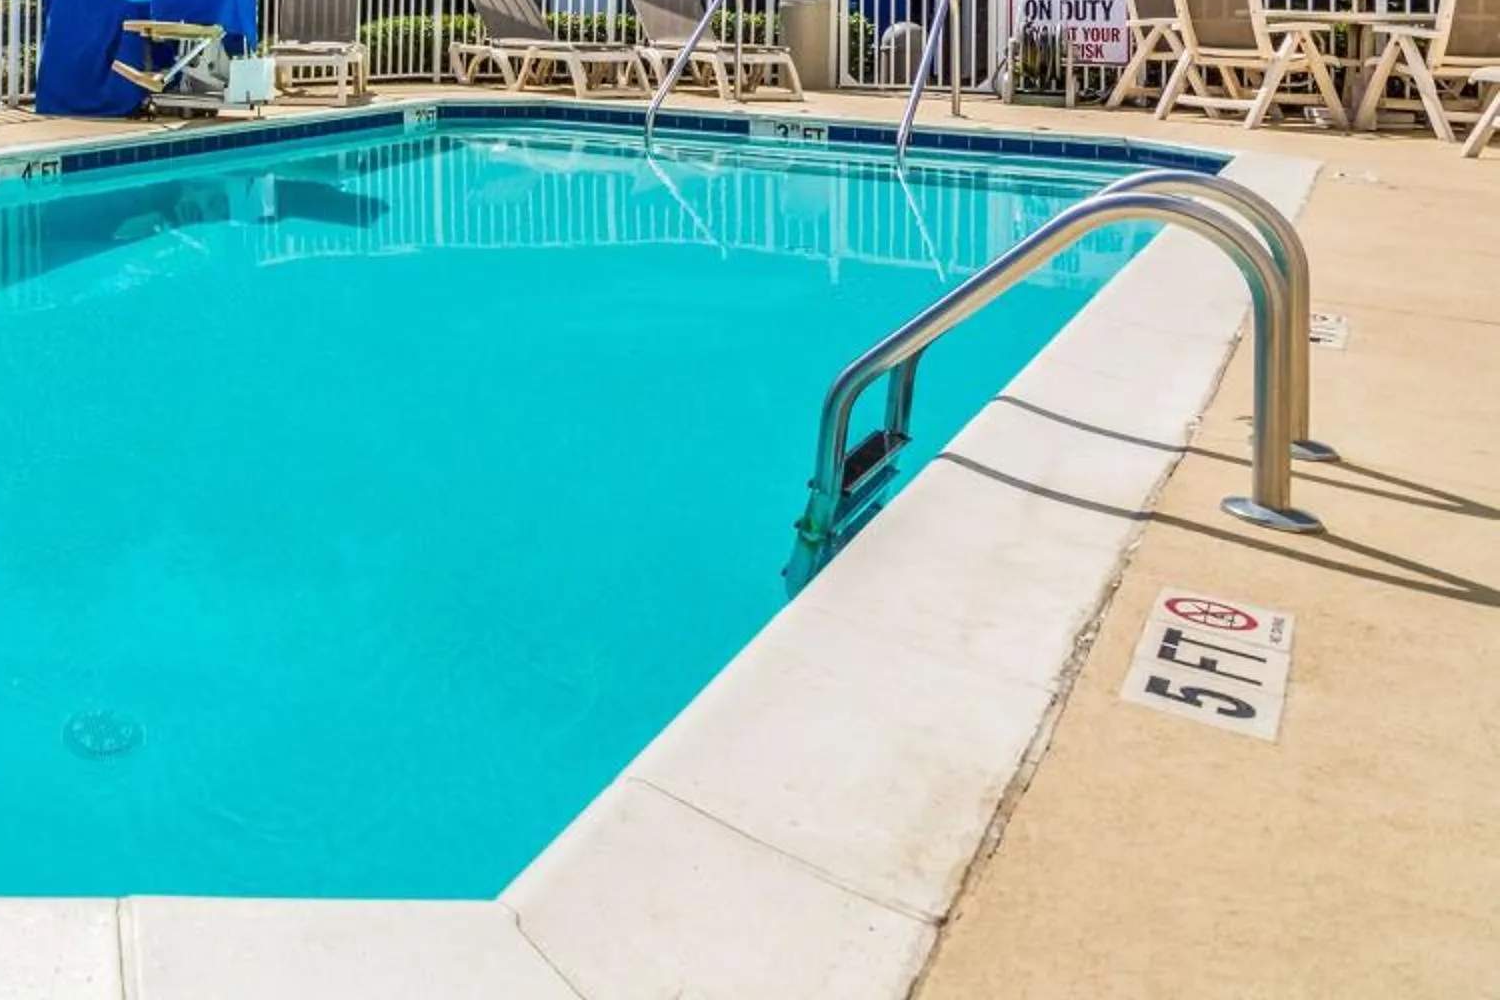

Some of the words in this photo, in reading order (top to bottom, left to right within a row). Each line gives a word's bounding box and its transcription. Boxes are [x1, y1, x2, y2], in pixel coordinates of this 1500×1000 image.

[1025, 0, 1051, 20] ON
[1060, 0, 1114, 21] DUTY
[1083, 27, 1120, 42] YOUR
[41, 161, 59, 177] FT
[1157, 627, 1267, 686] FT
[1145, 675, 1257, 718] 5
